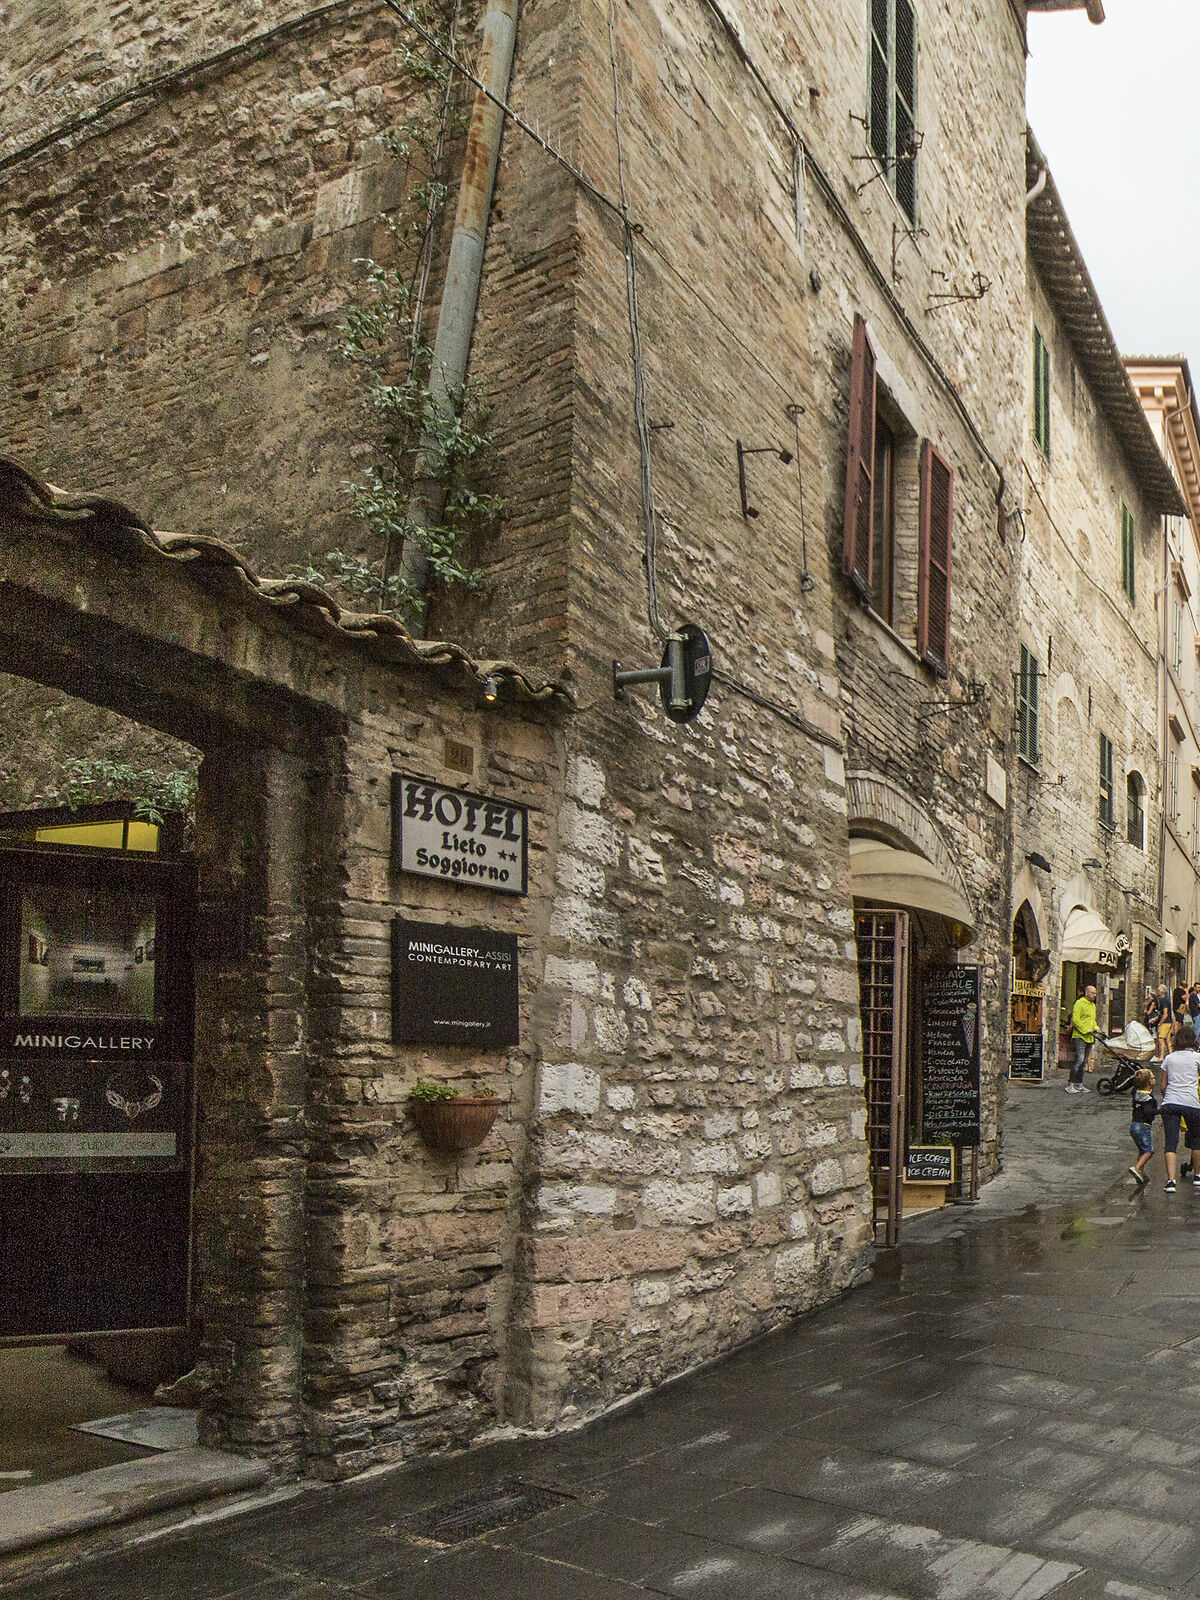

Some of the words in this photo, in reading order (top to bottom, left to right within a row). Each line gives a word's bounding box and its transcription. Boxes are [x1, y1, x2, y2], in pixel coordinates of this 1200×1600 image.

[403, 783, 521, 843] HOTEL
[441, 831, 487, 857] Lieto
[416, 848, 510, 882] Soggiorno
[408, 953, 491, 969] CONTEMPORARY
[495, 963, 512, 971] ART
[1026, 989, 1046, 997] testo
[433, 1019, 491, 1028] www.minigallery.it
[14, 1034, 155, 1049] MINIGALLERY
[908, 1168, 920, 1177] ICE
[921, 1167, 951, 1178] CREAM
